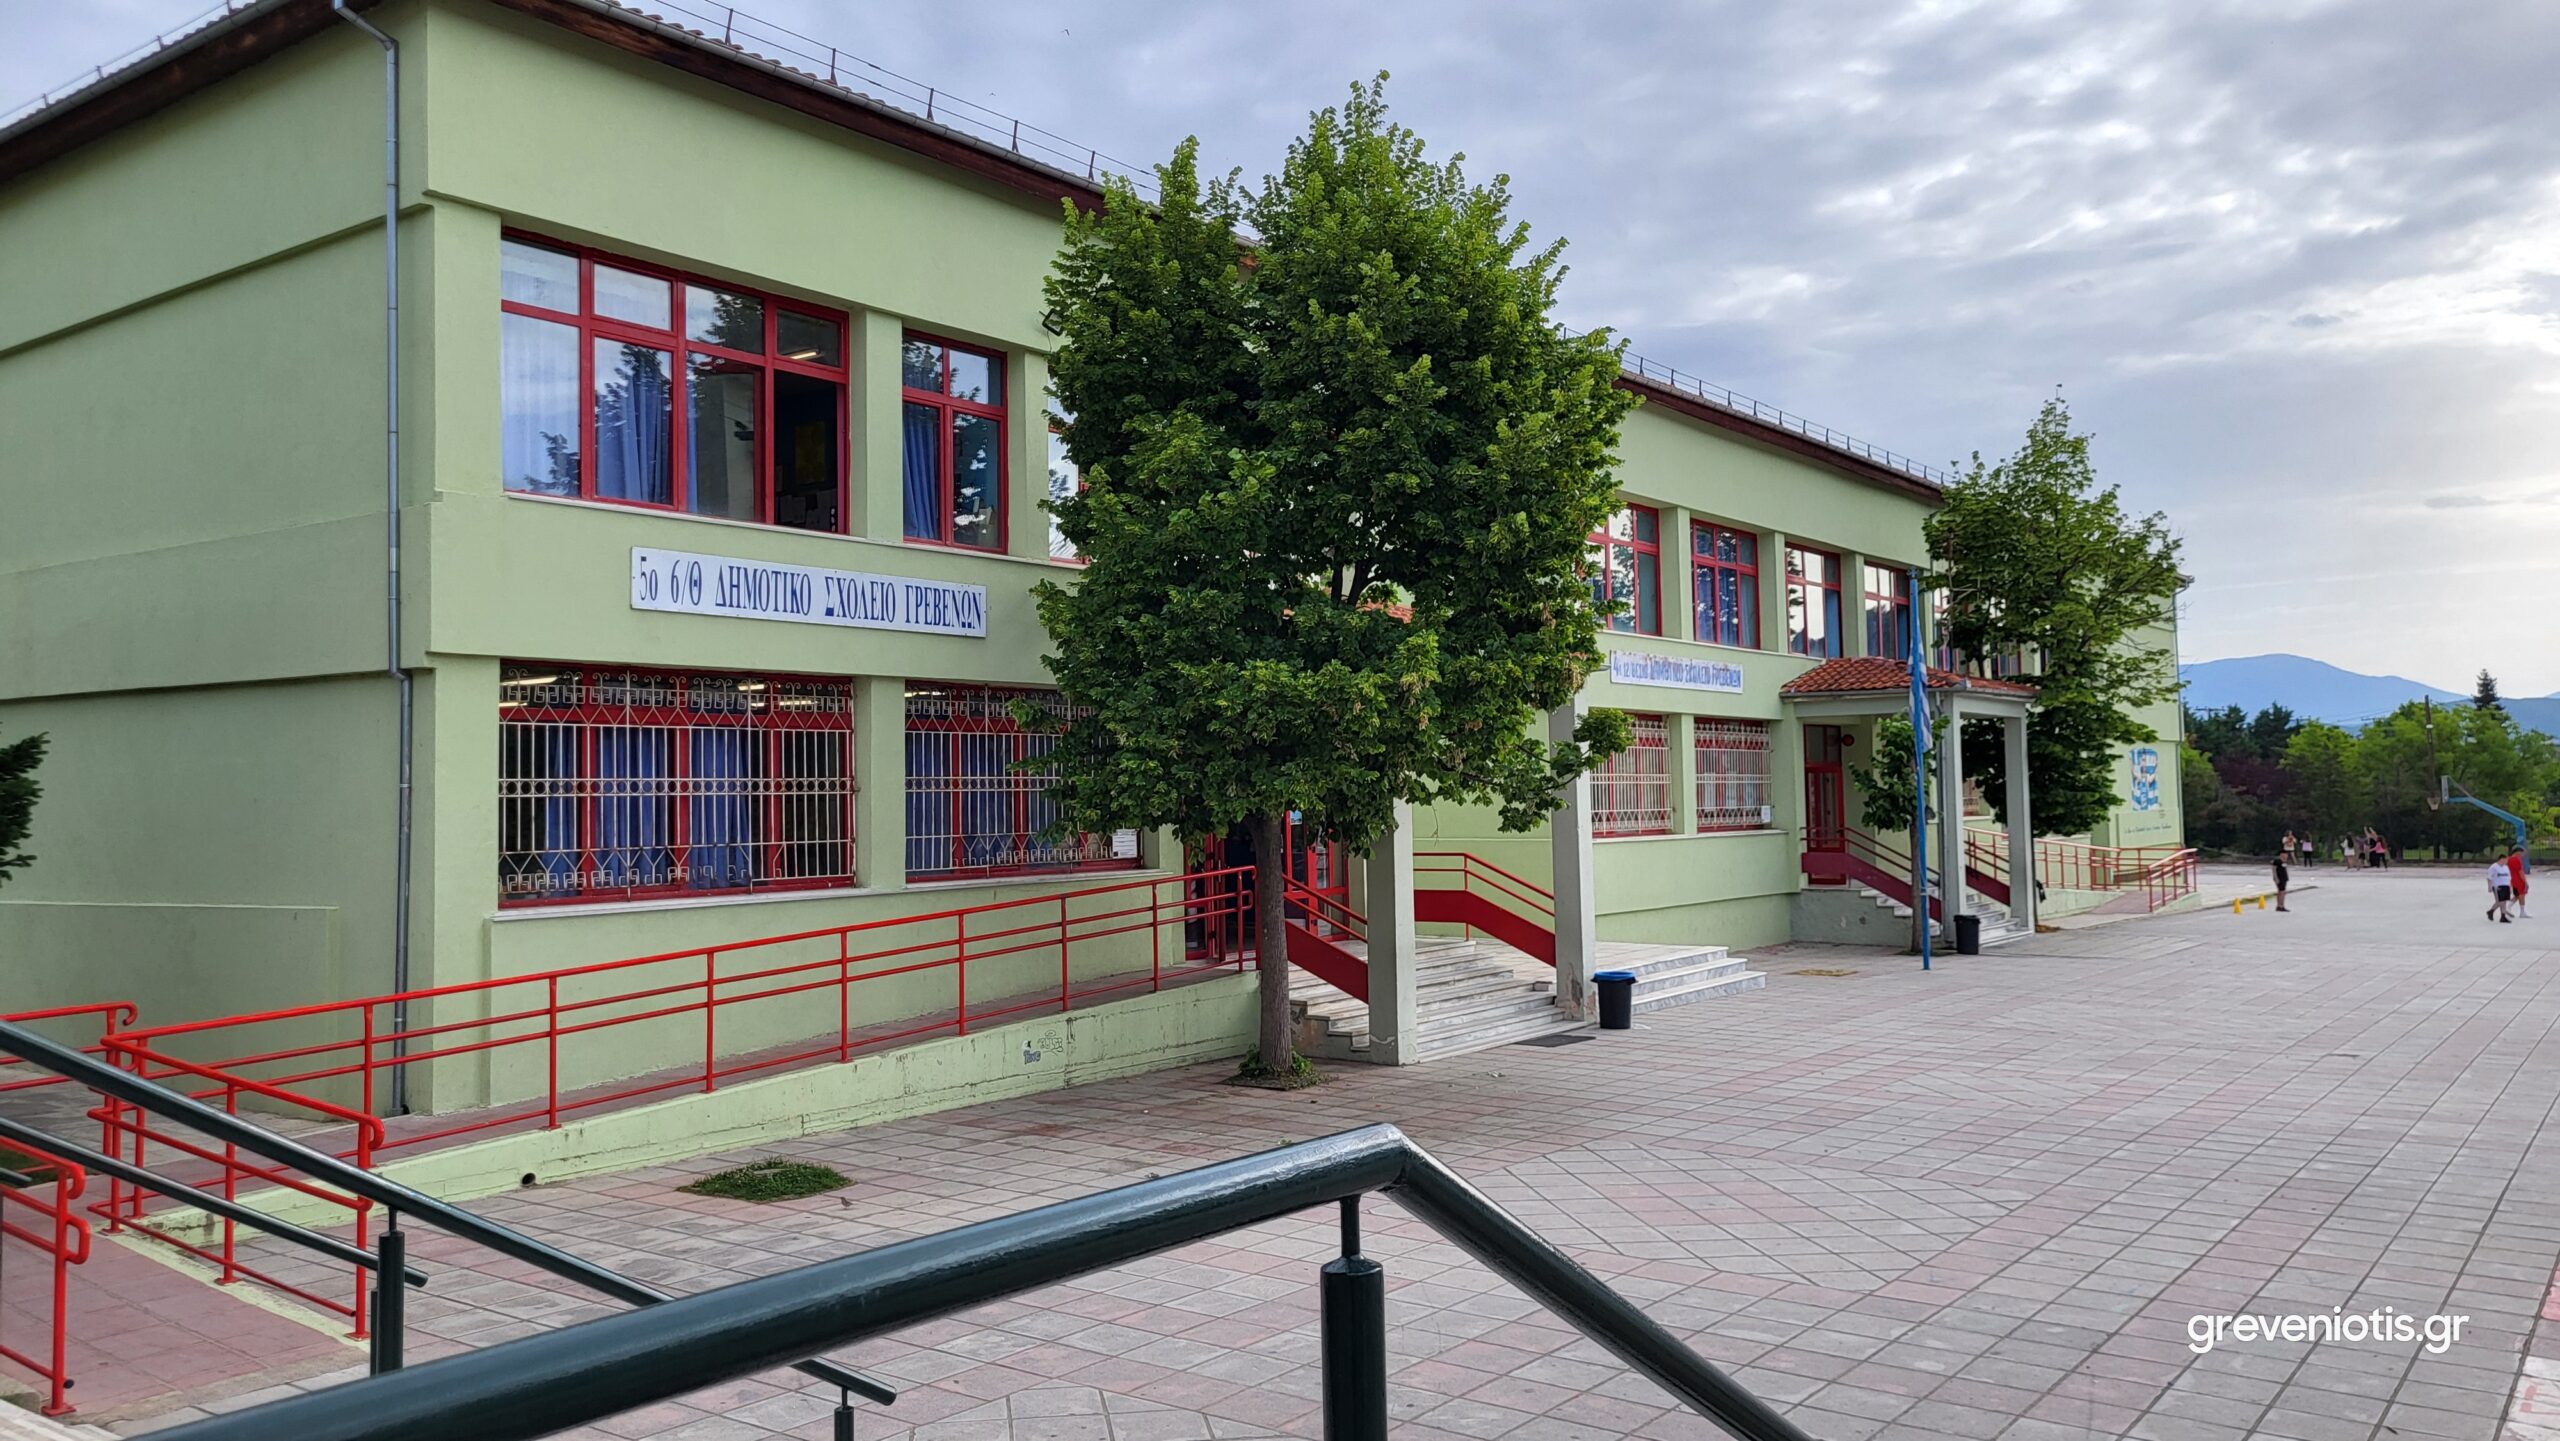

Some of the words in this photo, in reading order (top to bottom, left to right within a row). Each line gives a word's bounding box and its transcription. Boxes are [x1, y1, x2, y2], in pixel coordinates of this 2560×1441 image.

[639, 556, 658, 602] 5ο
[670, 560, 702, 606] 6/Θ
[715, 563, 811, 617] ΔΗΜΟΤΙΚΟ
[825, 575, 896, 624] ΣΧΟΛΕΙΟ
[905, 584, 982, 630] ΓΡΕΒΕΝΩΝ
